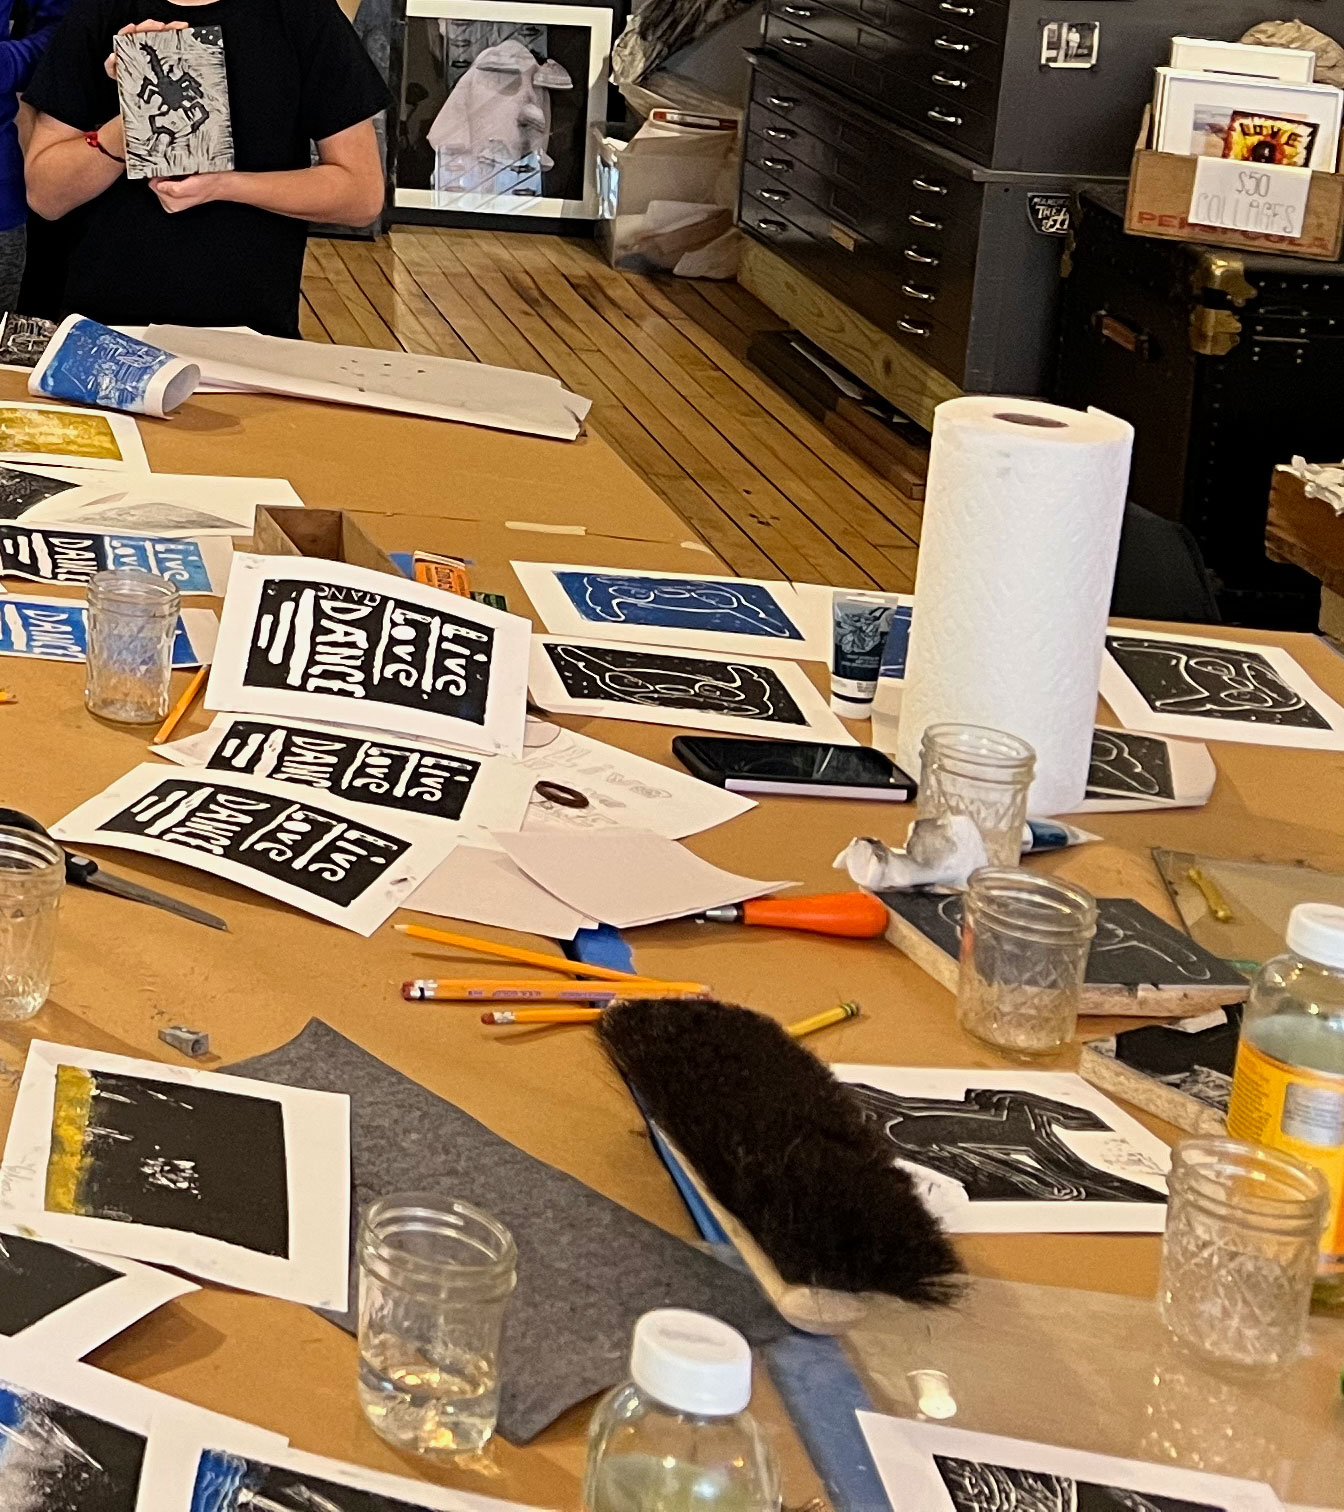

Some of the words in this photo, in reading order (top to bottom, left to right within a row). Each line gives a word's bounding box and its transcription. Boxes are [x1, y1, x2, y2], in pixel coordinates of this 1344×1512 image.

[1238, 122, 1304, 148] LOVE
[1235, 170, 1272, 198] $50
[306, 599, 373, 699] DANCE
[383, 607, 433, 689] Love
[435, 622, 489, 697] Live
[353, 744, 411, 795] Love
[409, 756, 473, 803] Live
[162, 793, 271, 856] DANCE
[254, 809, 339, 863] Love
[307, 828, 398, 883] Live
